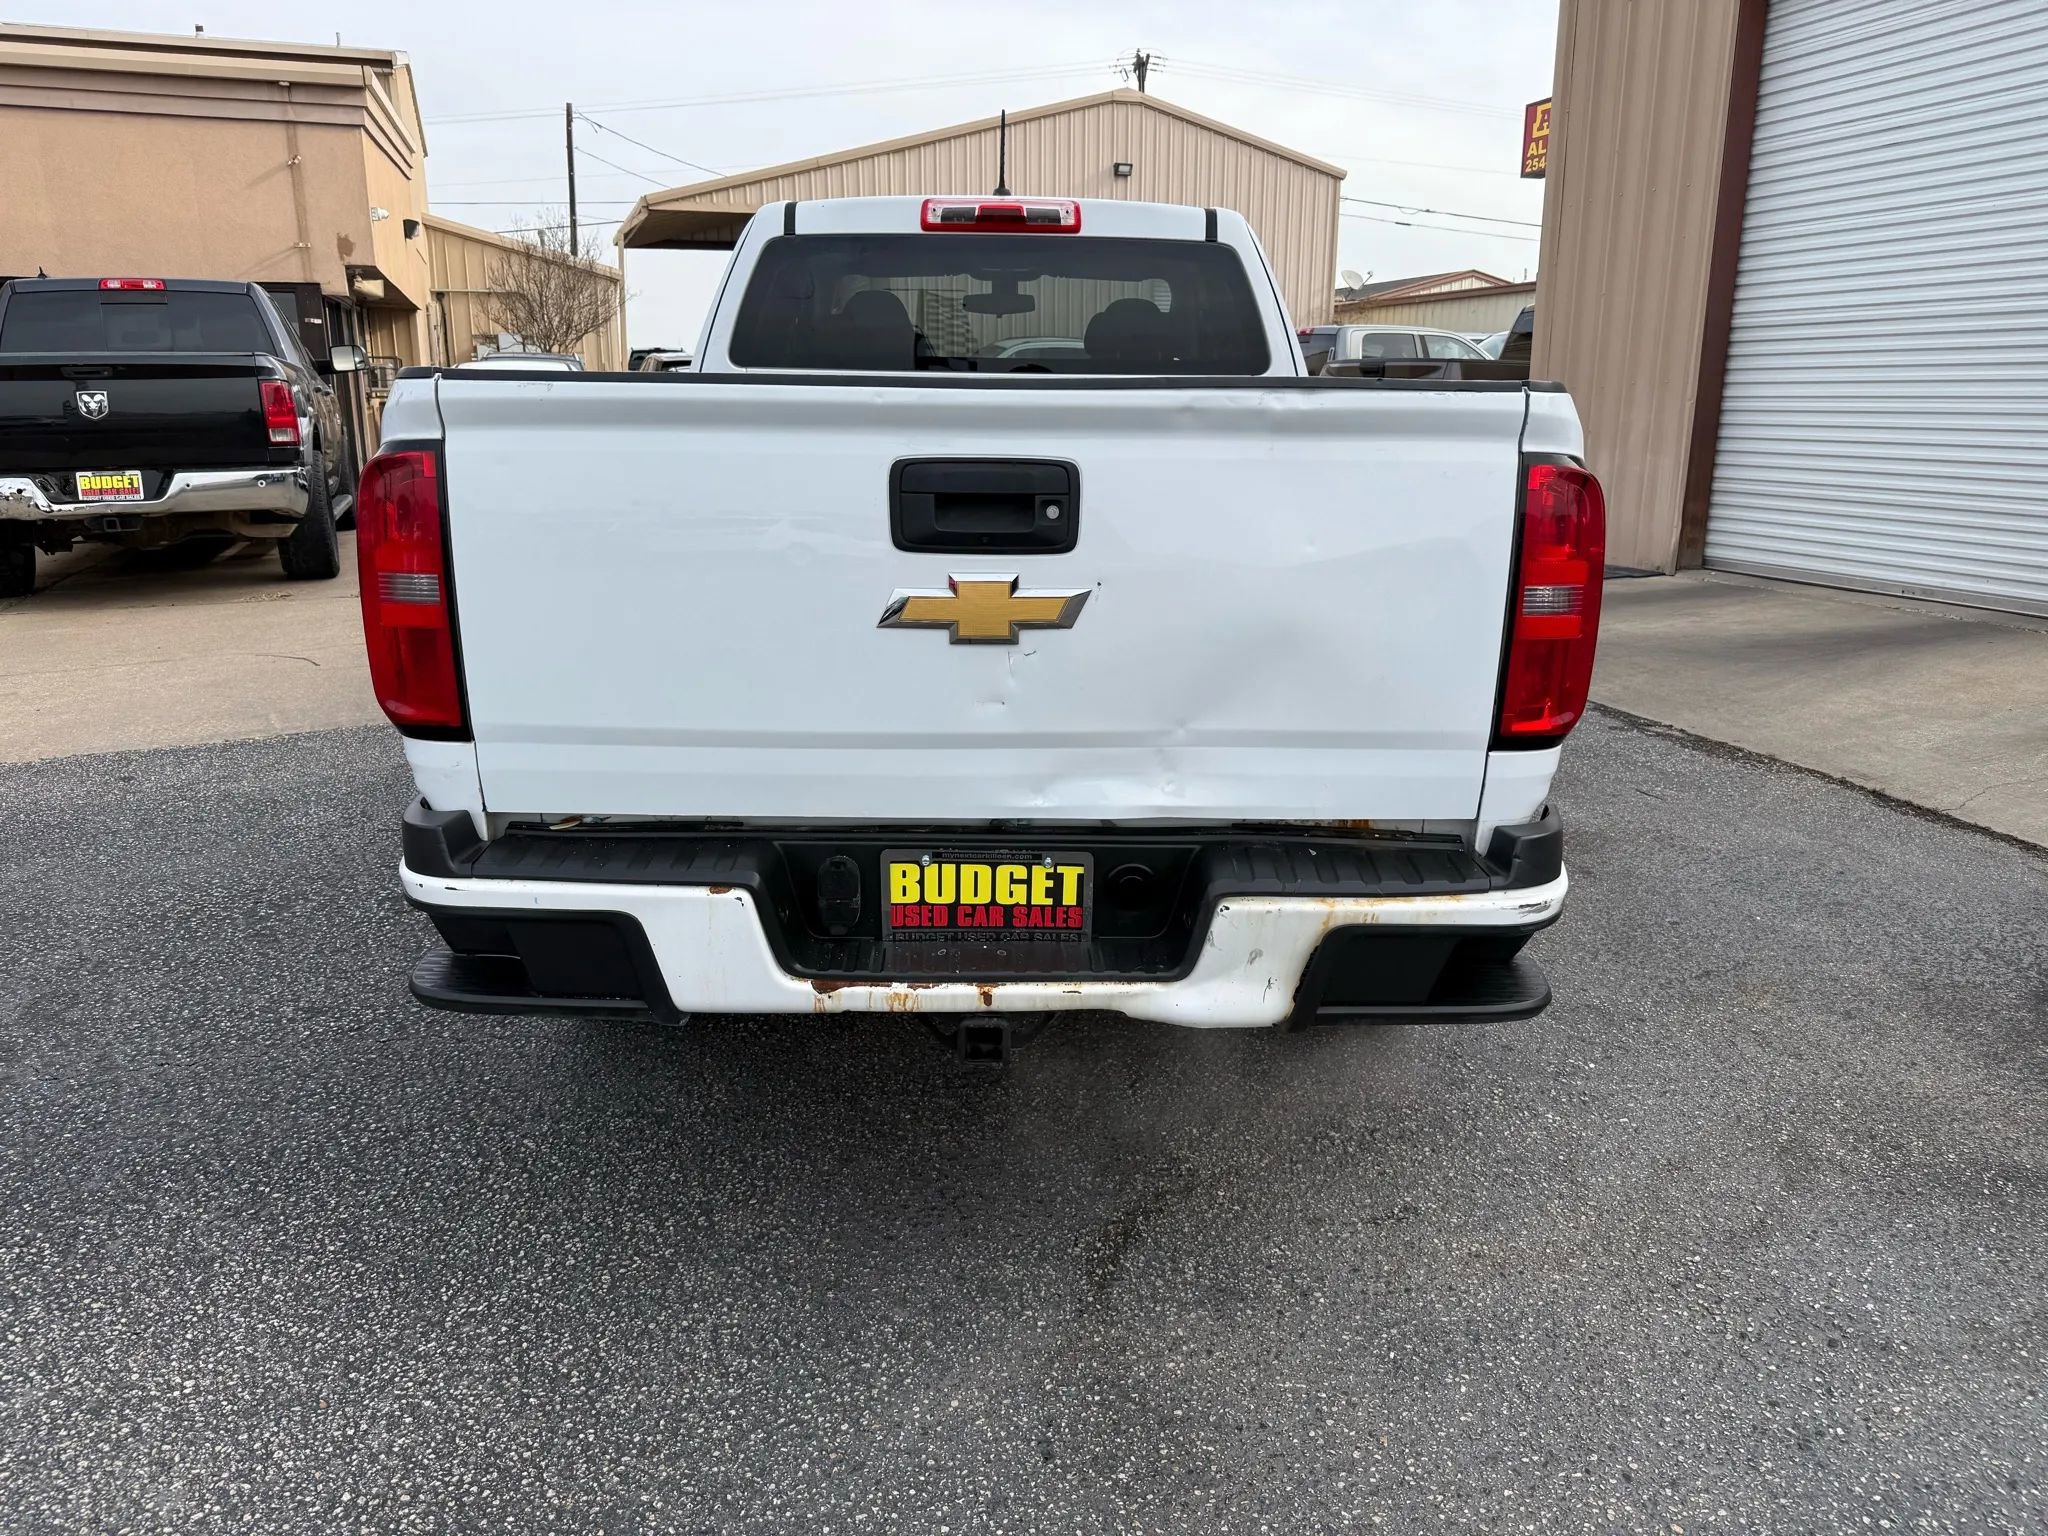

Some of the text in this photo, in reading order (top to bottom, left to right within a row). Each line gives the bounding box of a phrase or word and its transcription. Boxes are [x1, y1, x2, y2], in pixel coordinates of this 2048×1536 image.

[80, 475, 139, 489] BUDGET
[889, 863, 1085, 905] BUDGET
[891, 905, 1083, 928] USED CAR SALES
